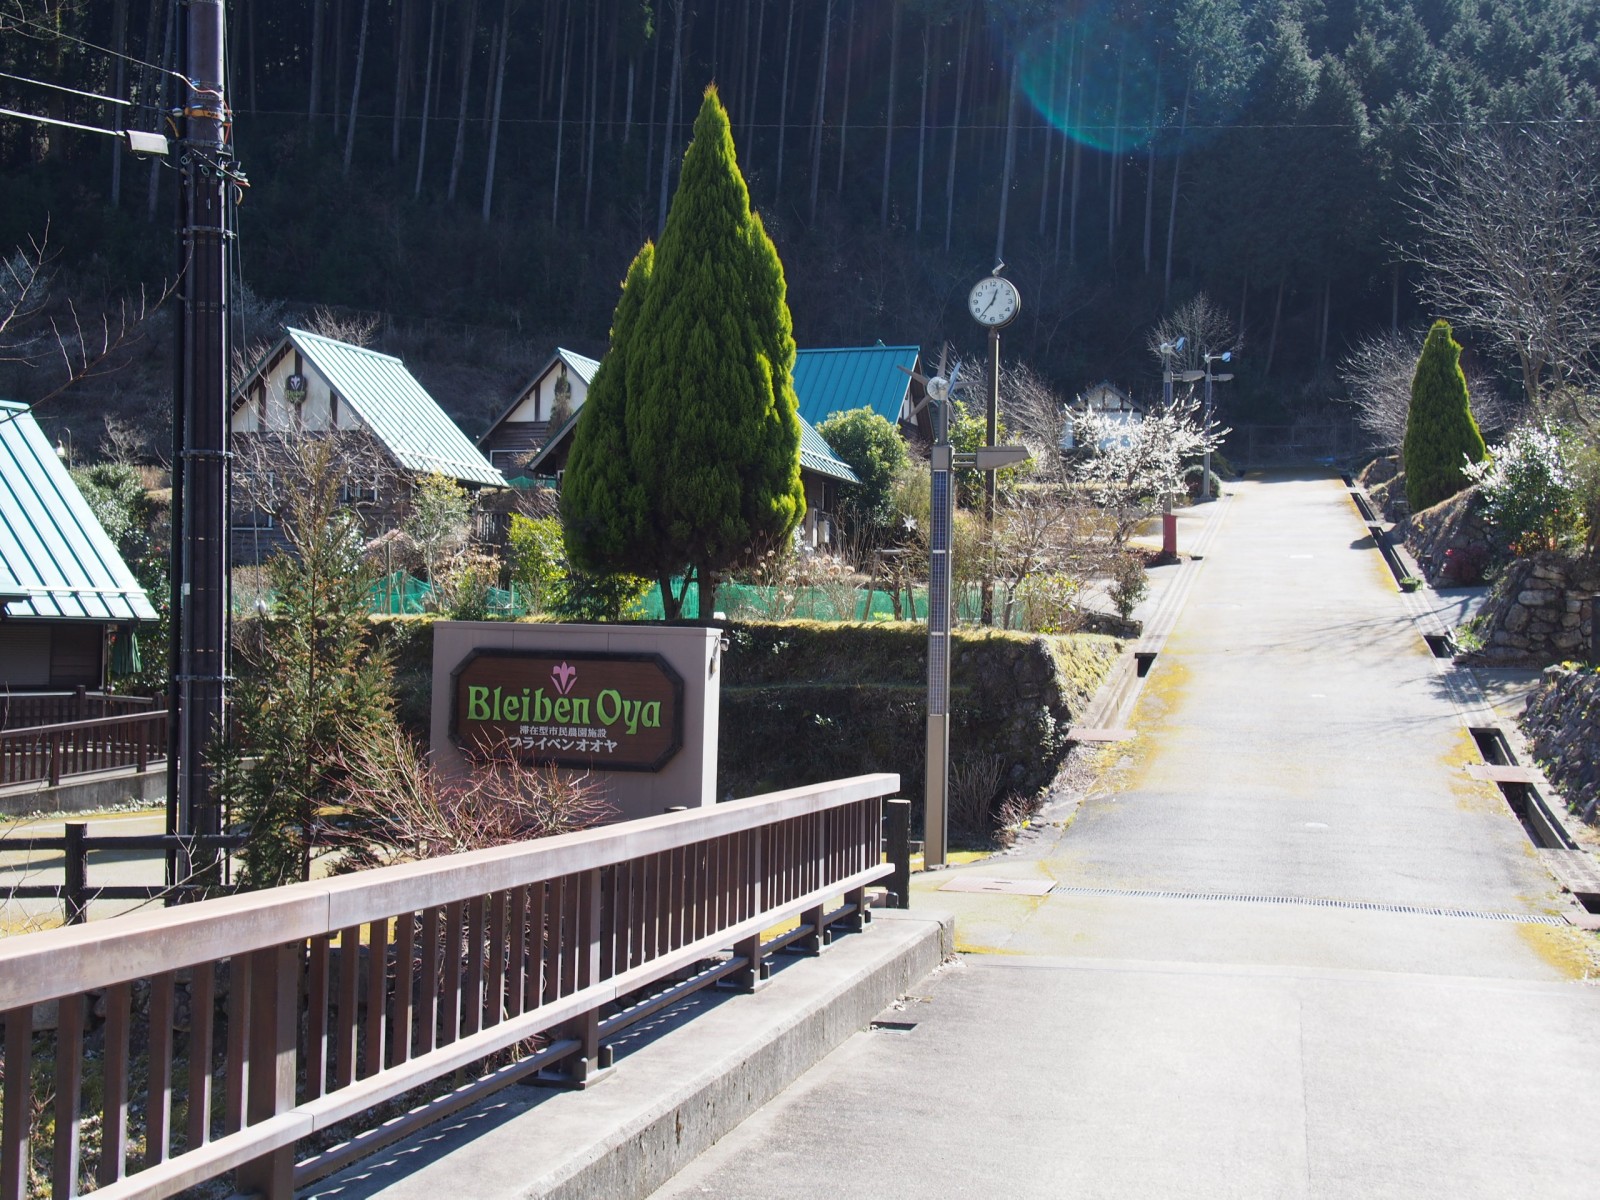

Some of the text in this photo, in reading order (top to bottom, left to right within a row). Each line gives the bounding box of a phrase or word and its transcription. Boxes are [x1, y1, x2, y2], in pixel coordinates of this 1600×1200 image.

[467, 685, 661, 734] Bleiben Oya
[519, 725, 607, 738] 滞在型市民農園施設
